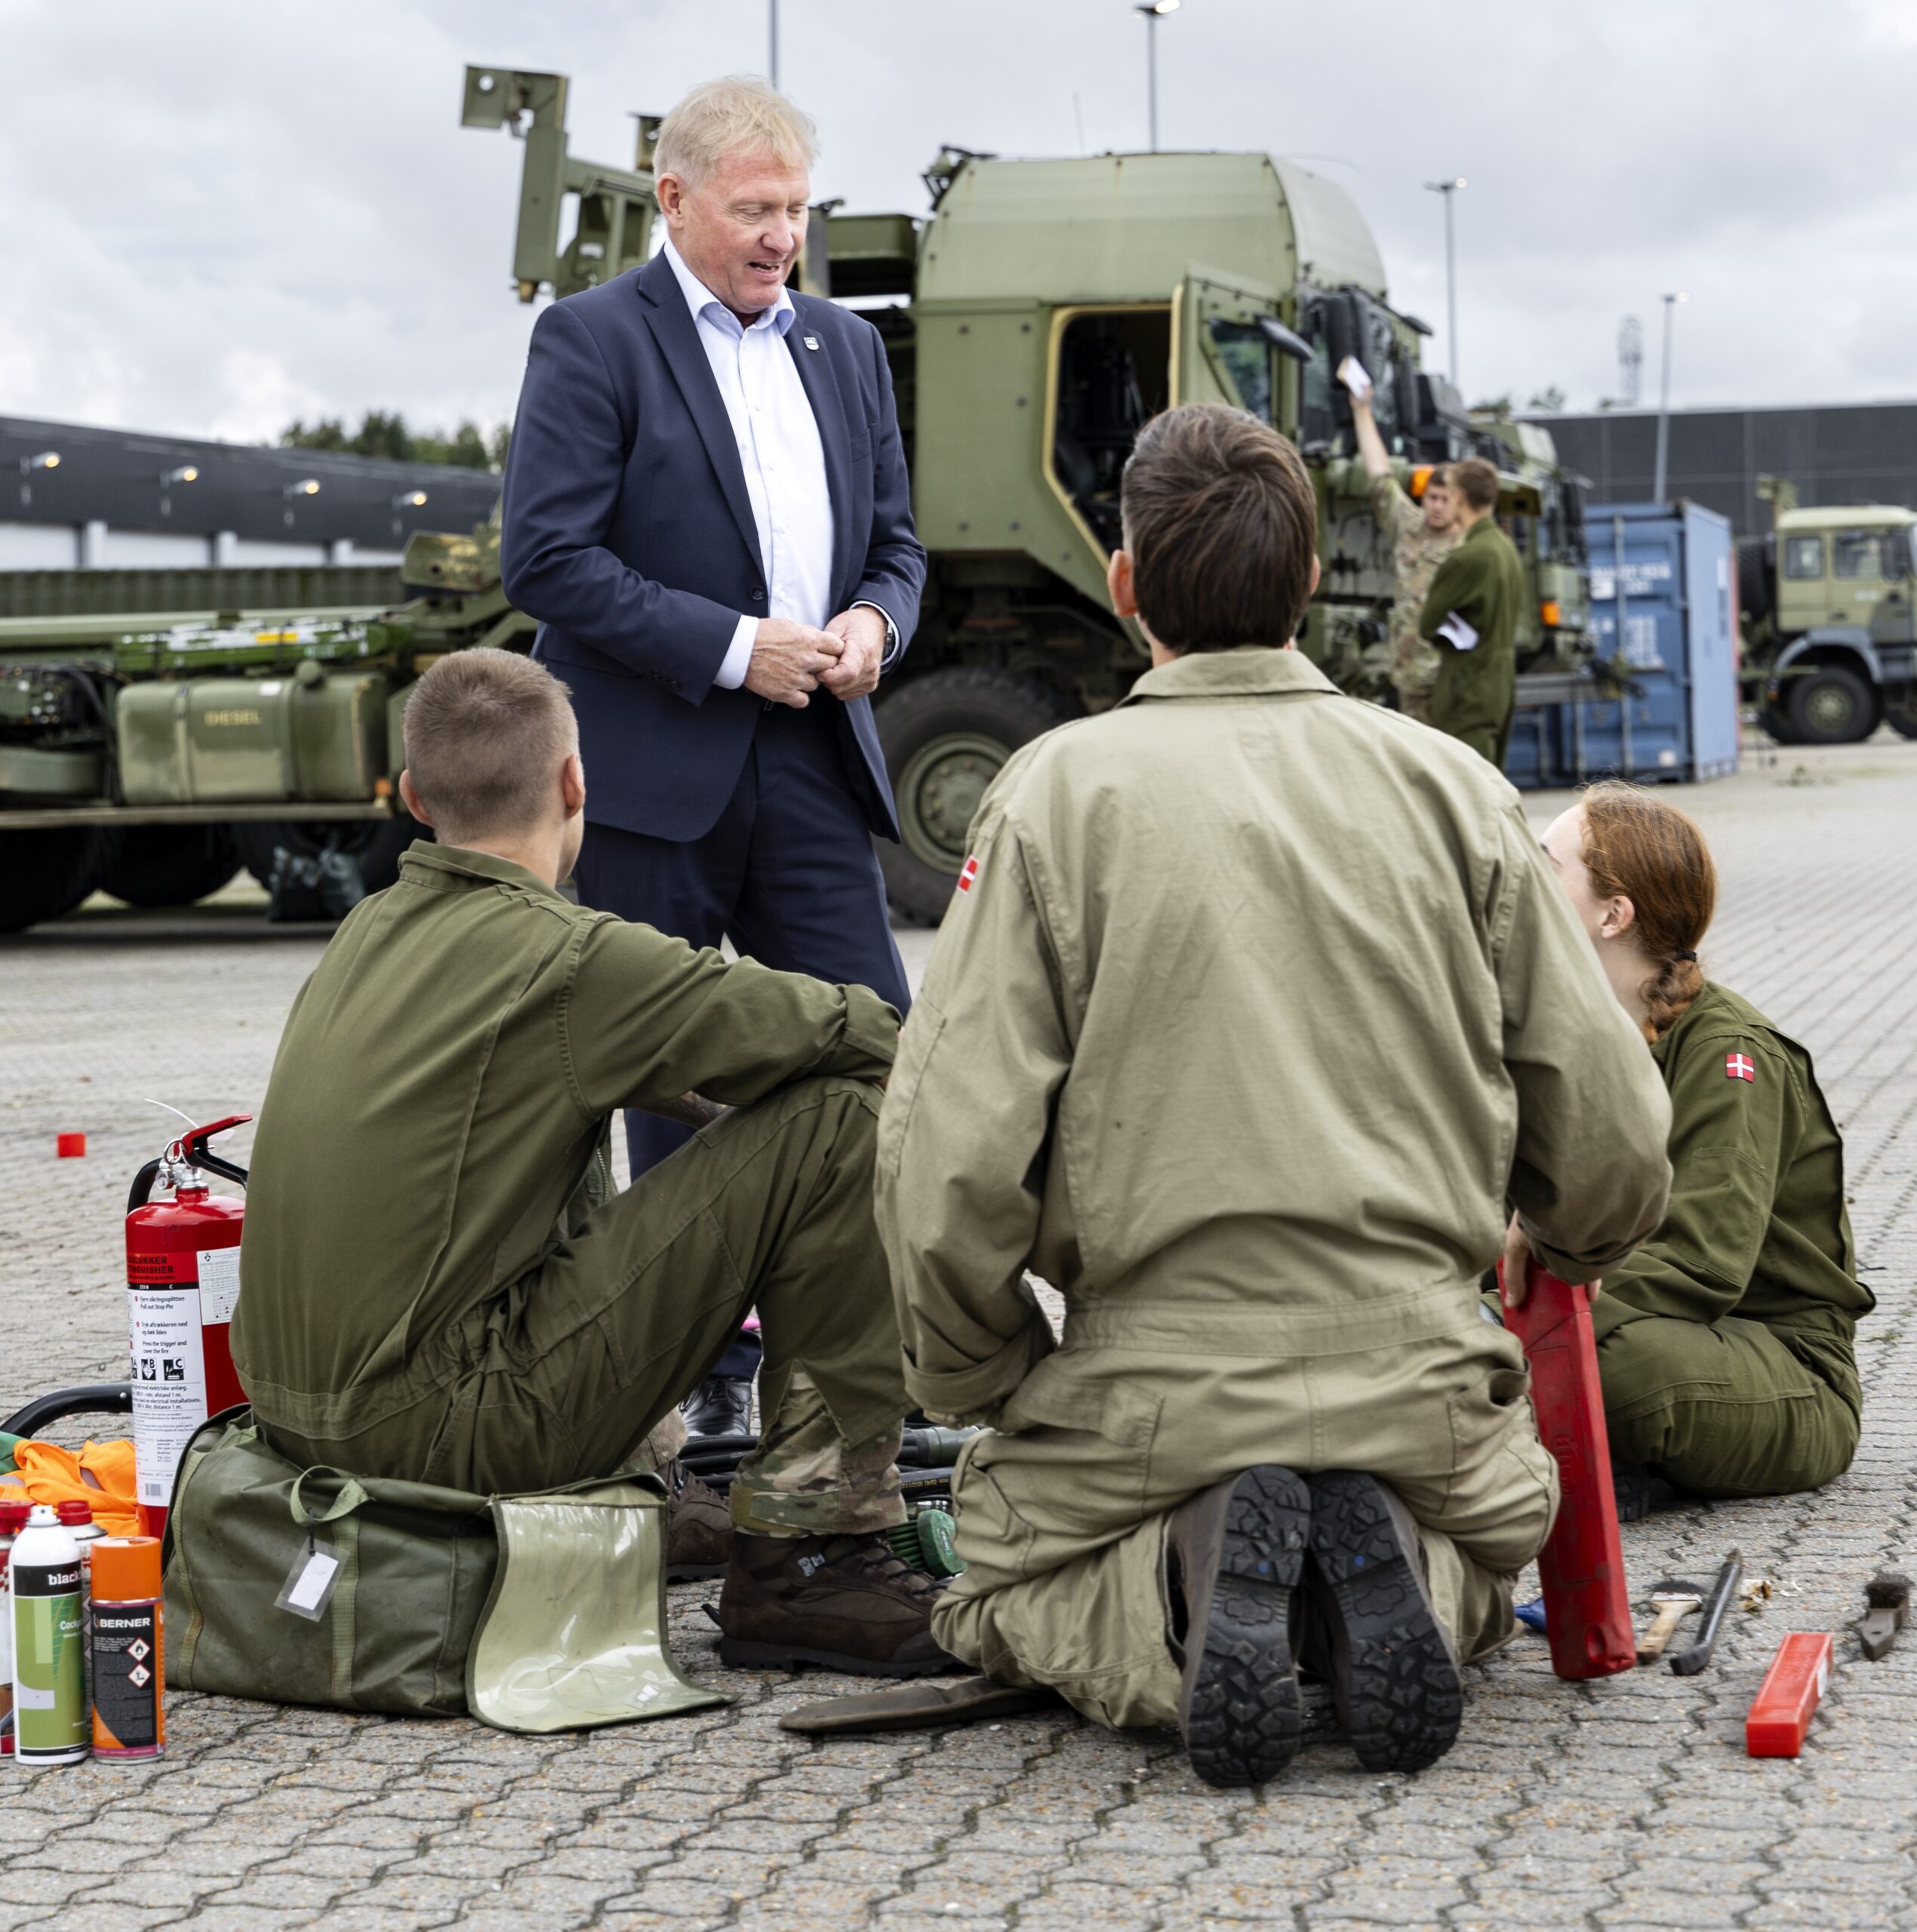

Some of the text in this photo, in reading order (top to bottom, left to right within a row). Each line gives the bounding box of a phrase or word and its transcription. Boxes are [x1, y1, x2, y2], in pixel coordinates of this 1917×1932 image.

[205, 710, 262, 725] DIESEL
[160, 1340, 177, 1348] trigger
[149, 1358, 155, 1368] B
[175, 1358, 183, 1368] C
[100, 1617, 151, 1629] BERNER
